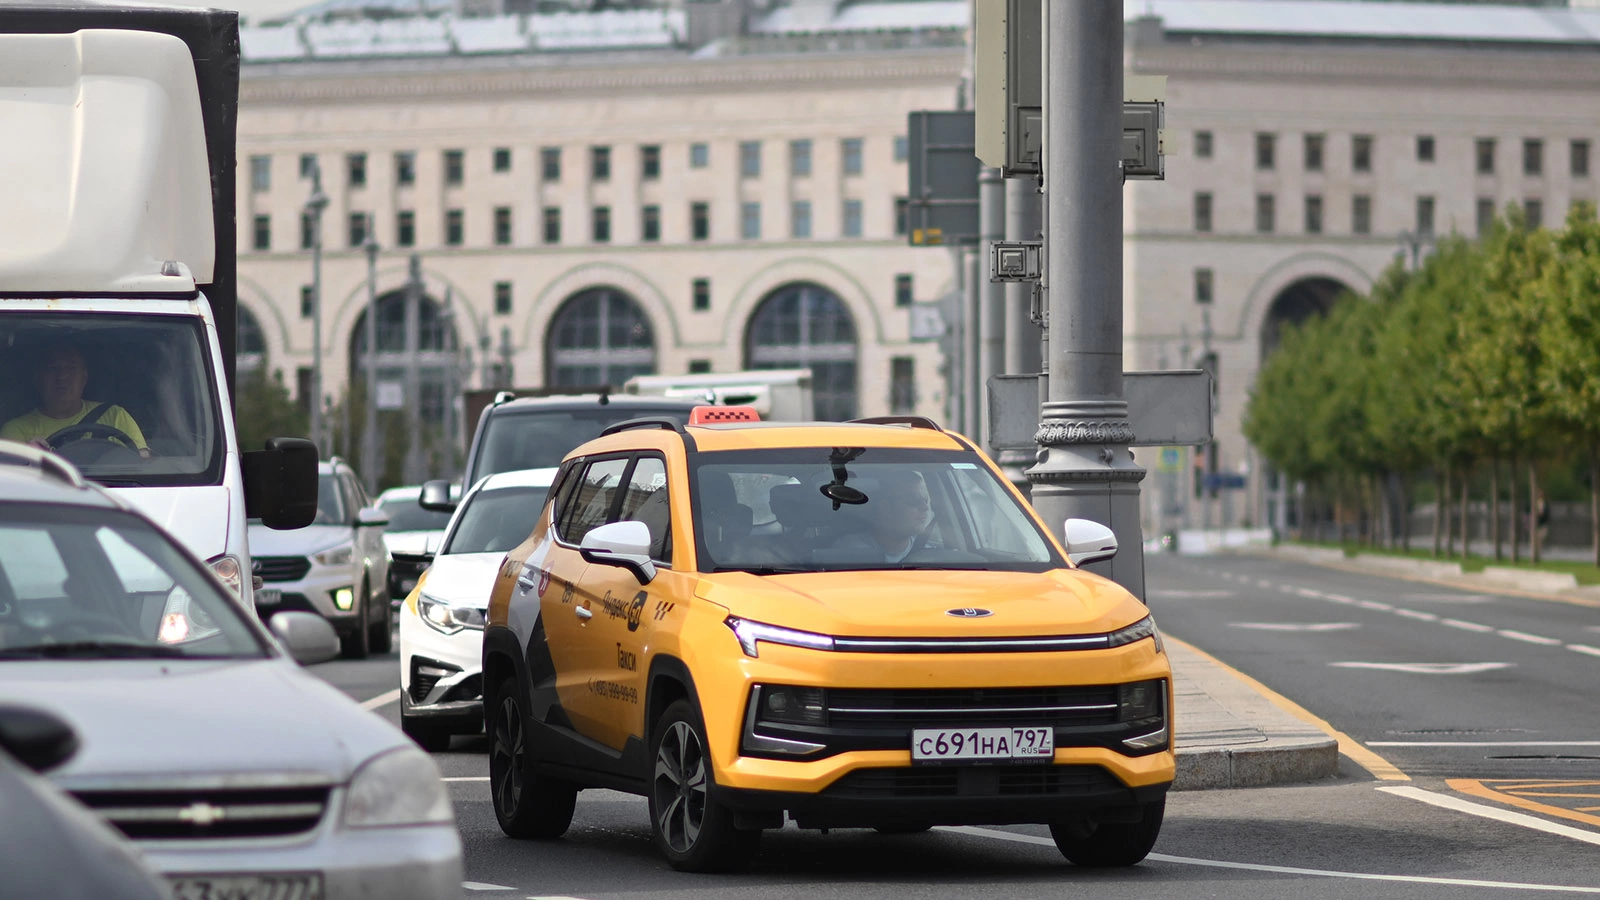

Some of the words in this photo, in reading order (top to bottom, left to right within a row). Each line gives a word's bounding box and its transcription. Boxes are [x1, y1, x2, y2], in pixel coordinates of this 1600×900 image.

[603, 590, 629, 620] Яндекс
[616, 642, 637, 673] Такси
[608, 682, 637, 704] 999-99-99
[920, 732, 1010, 755] С691НА
[1014, 730, 1047, 747] 797
